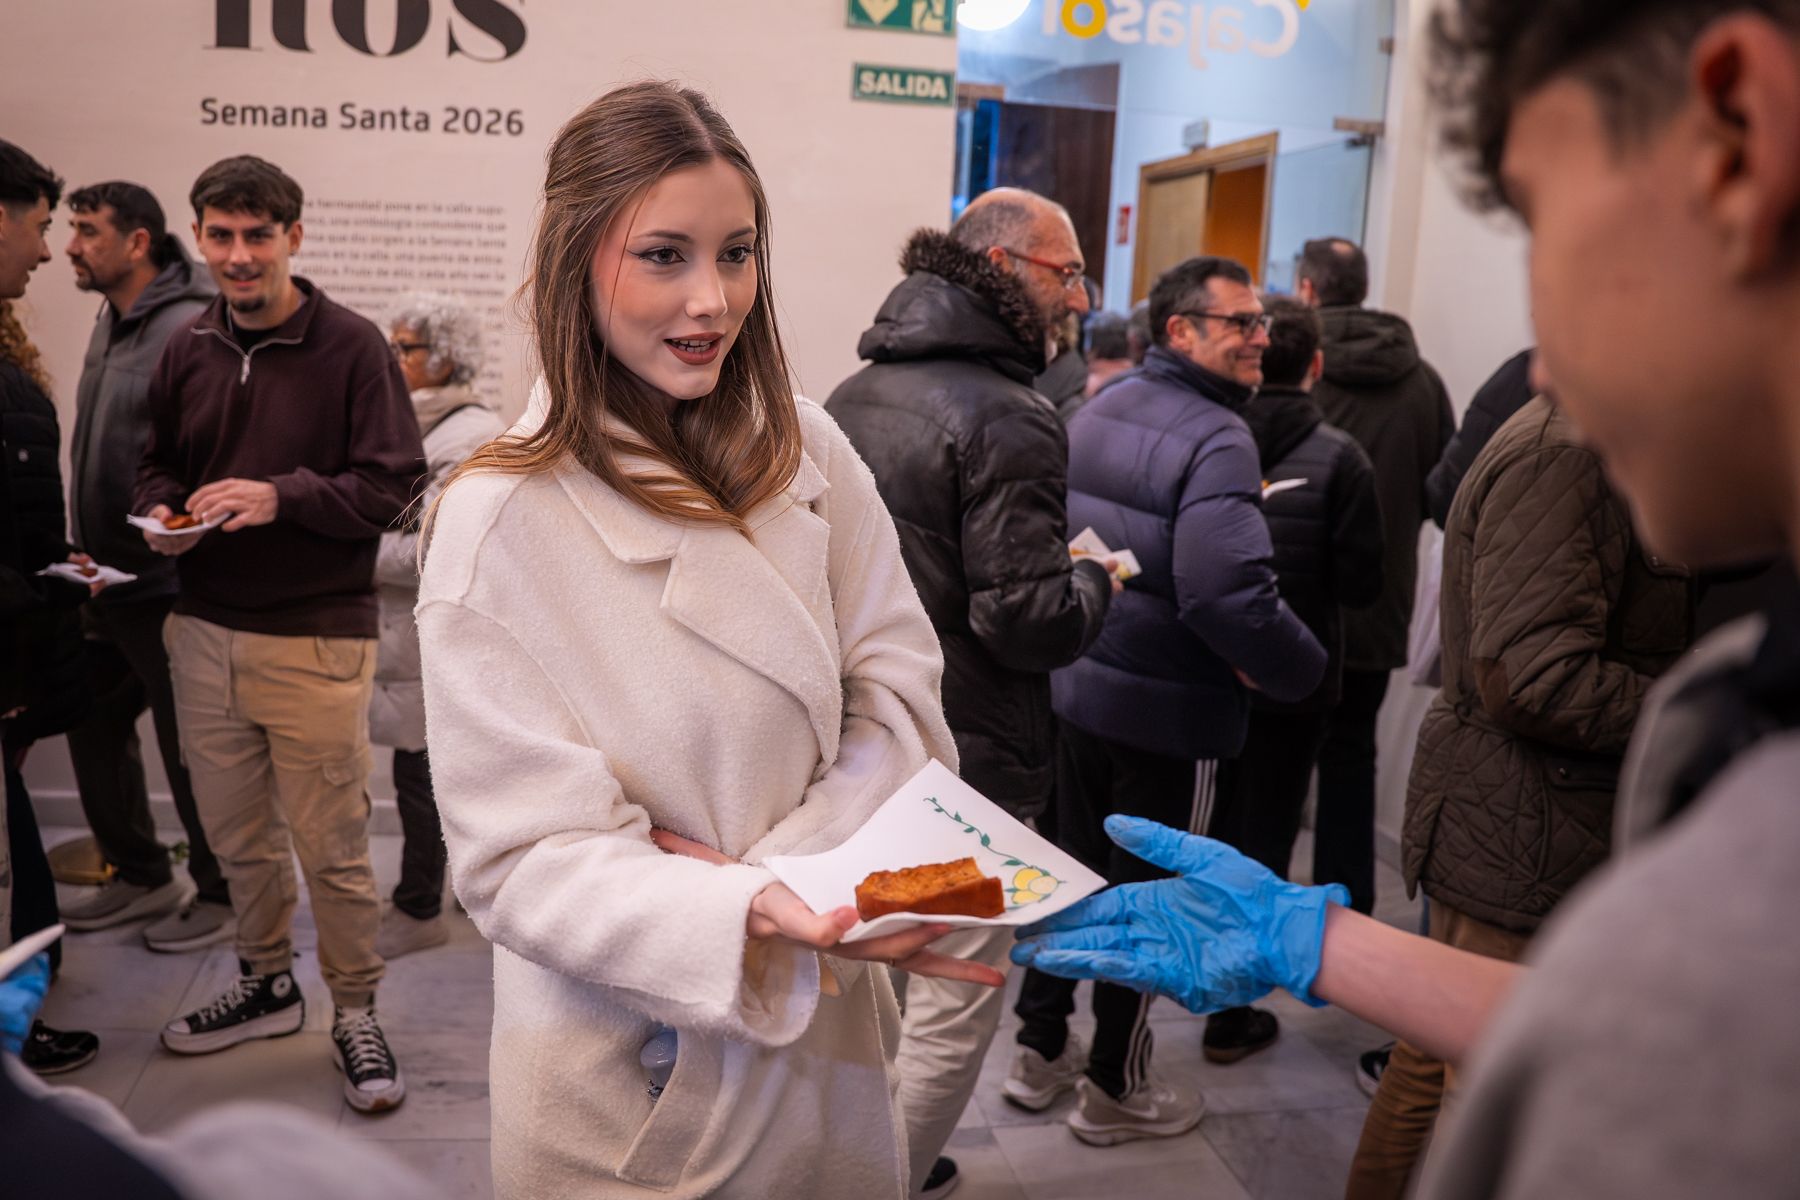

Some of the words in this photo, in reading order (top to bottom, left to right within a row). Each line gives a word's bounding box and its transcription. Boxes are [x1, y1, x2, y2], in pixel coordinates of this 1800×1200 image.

[860, 70, 948, 98] SALIDA
[200, 97, 328, 128] Semana
[339, 103, 431, 132] Santa
[443, 107, 524, 136] 2026
[318, 199, 382, 210] hermandad
